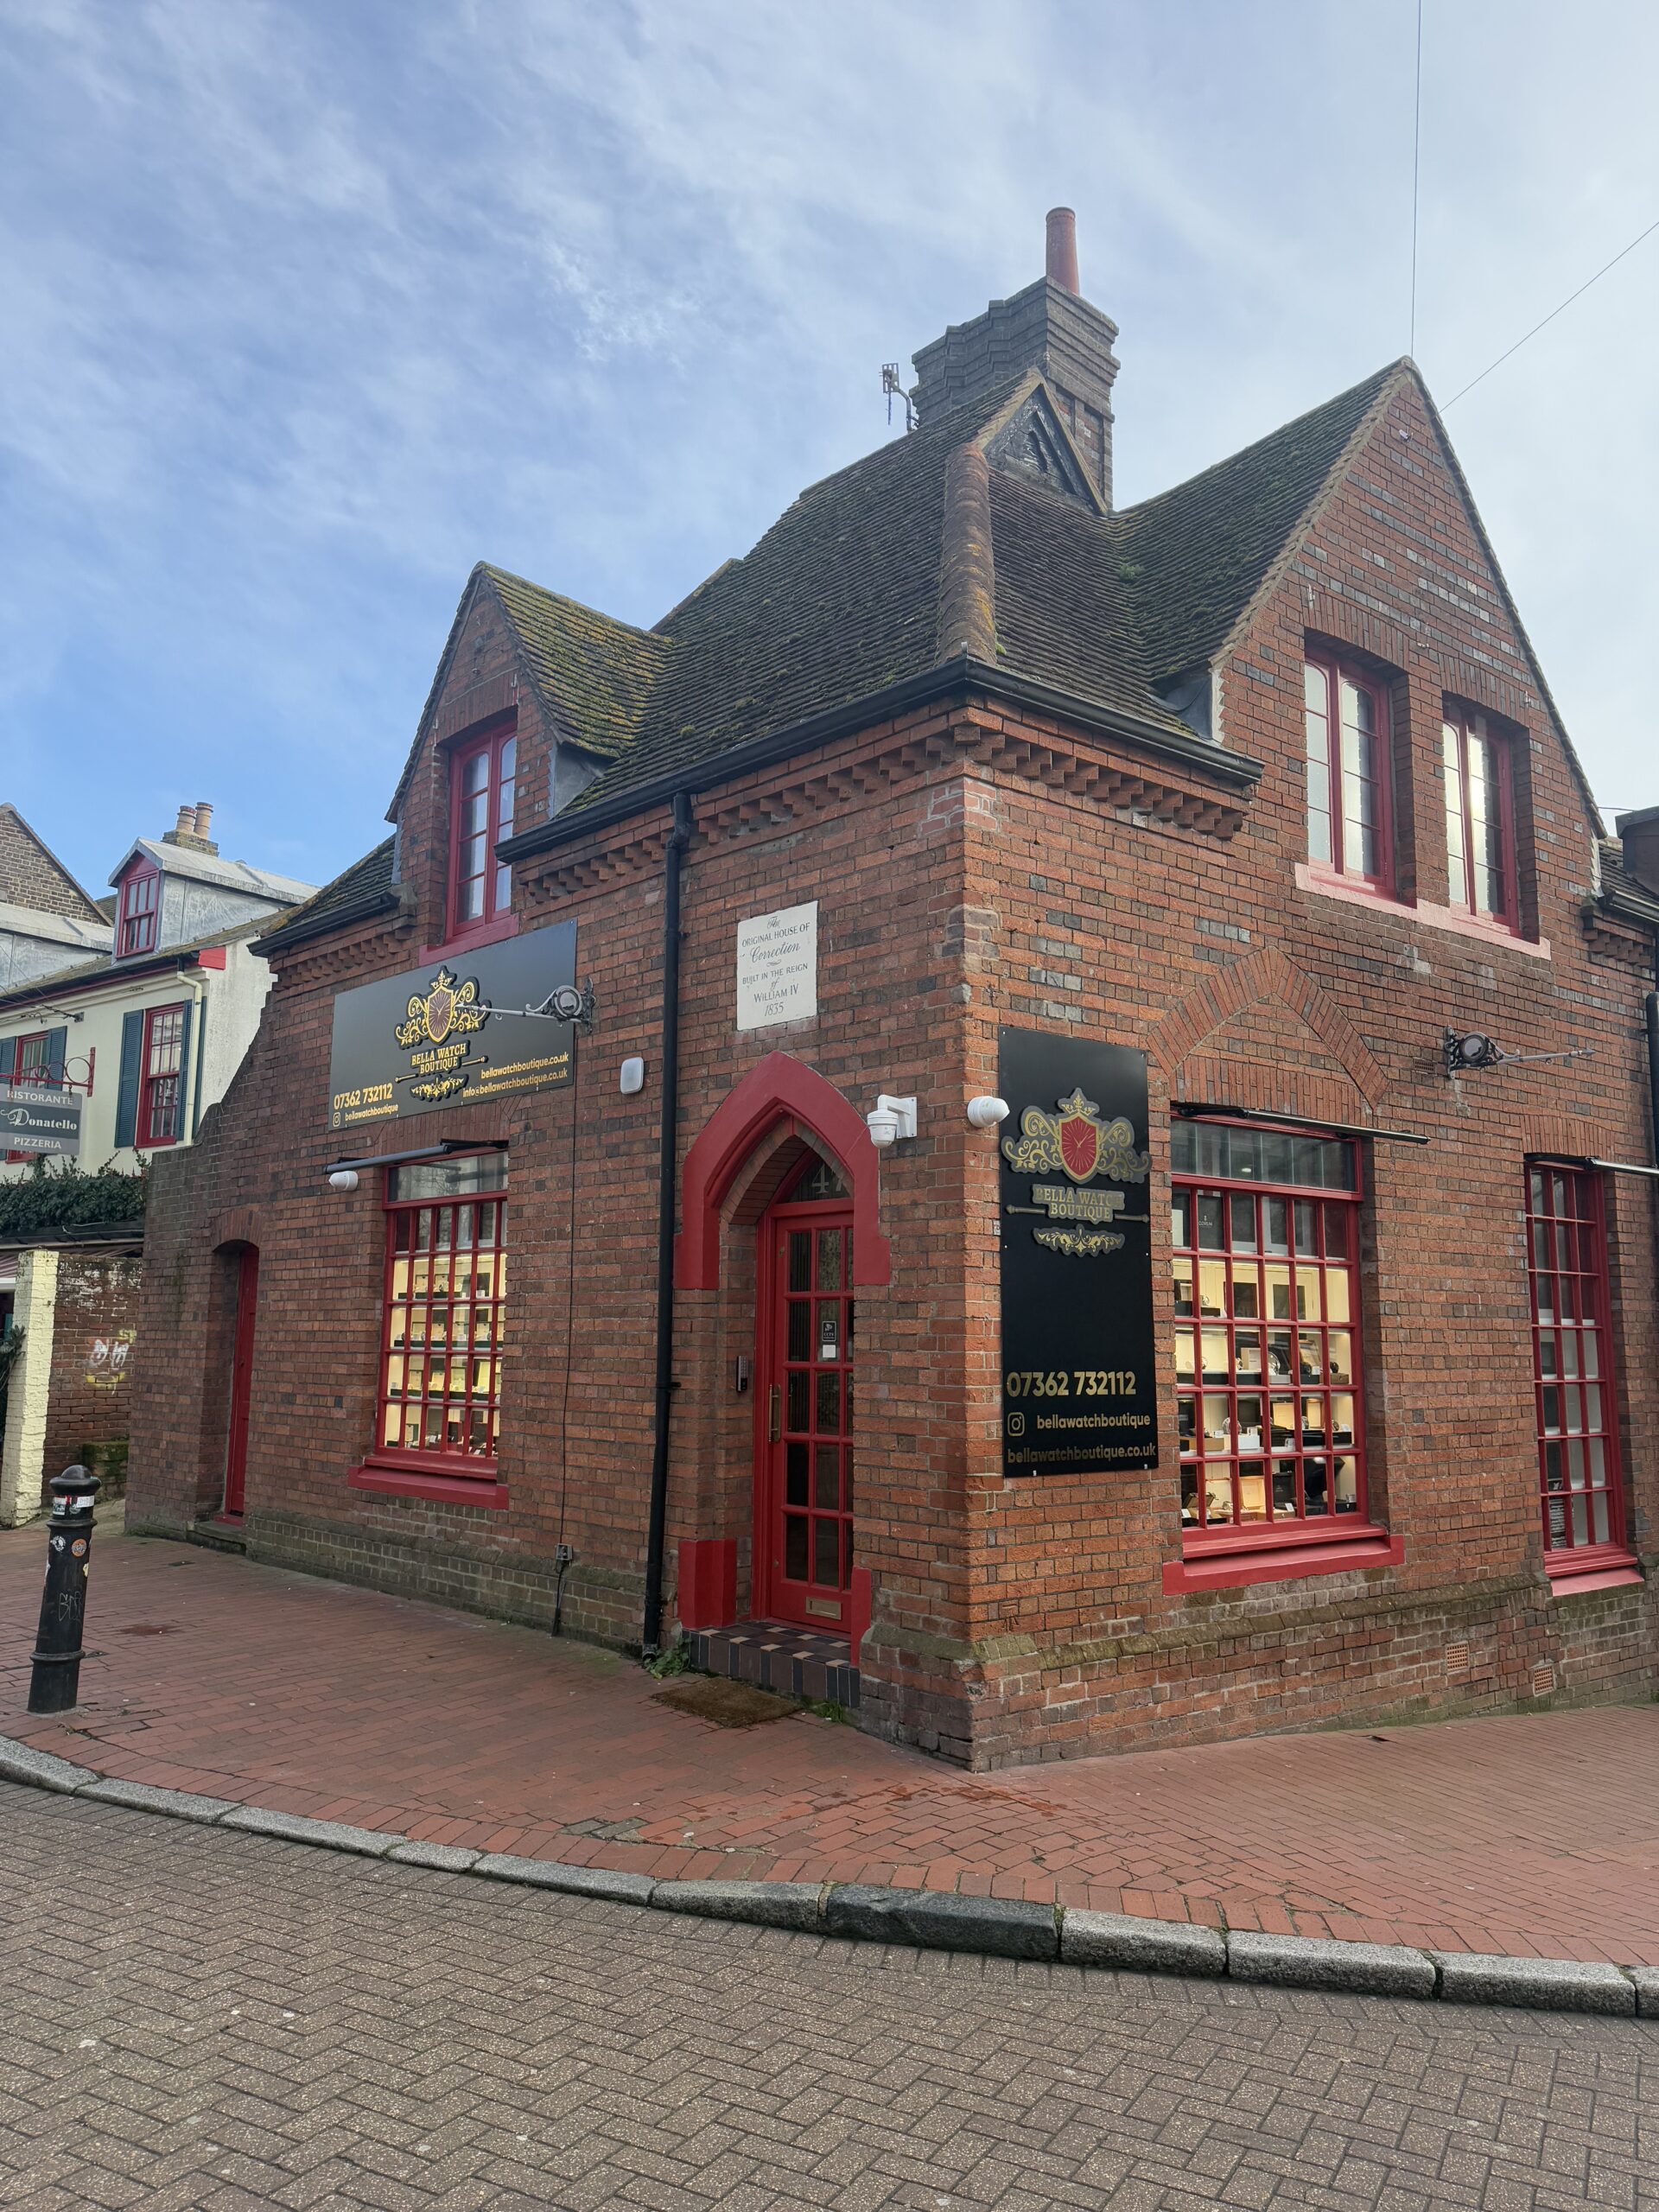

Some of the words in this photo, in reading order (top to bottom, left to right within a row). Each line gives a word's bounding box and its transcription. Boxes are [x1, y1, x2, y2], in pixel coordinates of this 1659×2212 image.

[767, 916, 781, 929] The
[742, 933, 772, 947] ORIGINAL
[774, 926, 798, 939] HOUSE
[799, 922, 810, 931] OF
[750, 943, 801, 963] Correction
[742, 974, 759, 985] BUILT
[761, 971, 768, 980] IN
[771, 968, 784, 978] THE
[786, 963, 808, 974] REIGN
[771, 977, 780, 991] of
[753, 989, 788, 1003] WILLIAM
[790, 983, 799, 995] IV
[764, 1001, 785, 1016] 1835
[411, 1050, 435, 1066] BELLA
[436, 1043, 466, 1061] WATCH
[419, 1056, 458, 1075] BOUTIQUE
[480, 1052, 569, 1079] bellawatchboutique.co.uk
[462, 1068, 568, 1098] info@bellawatchboutique.co.uk
[7, 1090, 73, 1106] RISTORANTE
[334, 1090, 360, 1110] 07362
[362, 1083, 393, 1103] 732112
[1, 1108, 78, 1130] Donatello
[344, 1103, 398, 1122] bellawatchboutique
[14, 1137, 62, 1150] PIZZERIA
[1034, 1186, 1075, 1204] BELLA
[1078, 1191, 1123, 1206] WATCH
[1050, 1205, 1111, 1221] BOUTIQUE
[1006, 1370, 1070, 1397] 07362
[1074, 1370, 1136, 1395] 732112
[1037, 1412, 1151, 1429] bellawatchboutique
[1007, 1442, 1156, 1464] bellawatchboutique.co.uk
